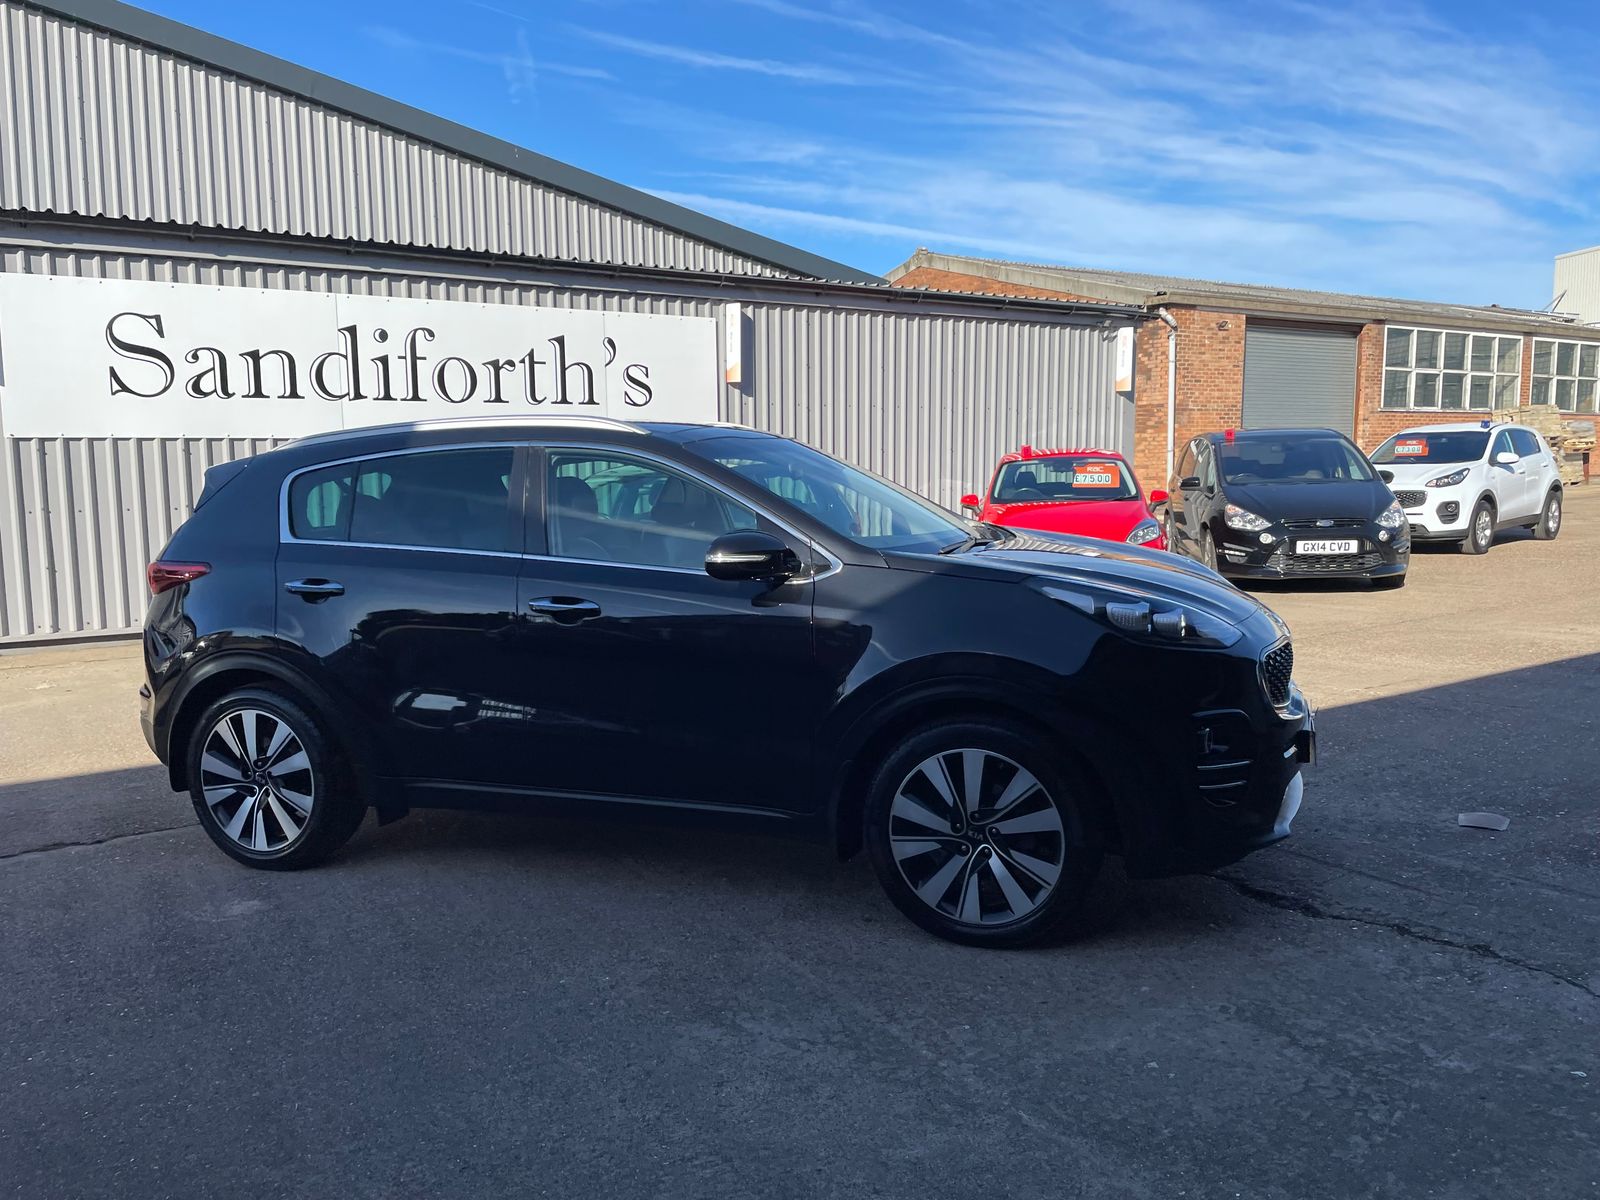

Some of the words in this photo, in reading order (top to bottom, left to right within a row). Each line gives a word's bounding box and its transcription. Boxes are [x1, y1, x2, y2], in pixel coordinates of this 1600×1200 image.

[105, 311, 653, 408] Sandiforth's
[1075, 474, 1110, 483] £7500
[1303, 542, 1327, 552] GX14
[1329, 542, 1350, 551] CVD
